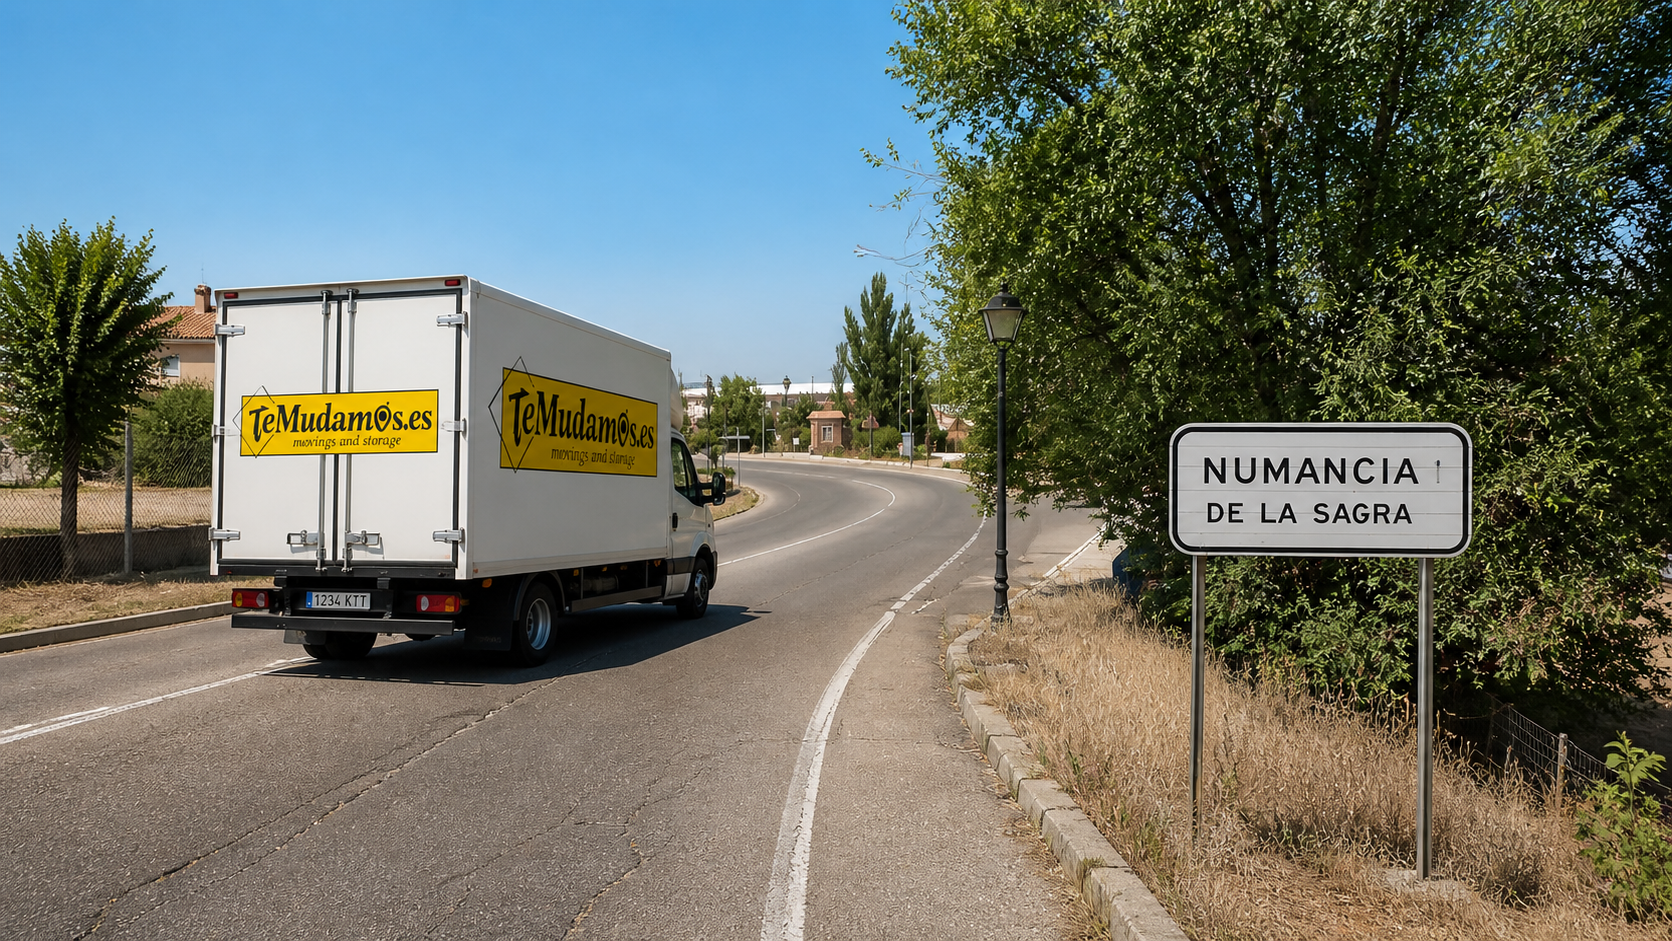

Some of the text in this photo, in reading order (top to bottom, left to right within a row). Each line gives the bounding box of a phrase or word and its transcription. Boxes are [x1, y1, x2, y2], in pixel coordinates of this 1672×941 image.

[339, 434, 360, 447] and
[362, 435, 402, 449] storage
[591, 448, 608, 464] and
[1203, 457, 1419, 485] NUMANCIA
[1206, 502, 1413, 525] DE LA SAGRA
[314, 593, 367, 608] 1234 KTT
